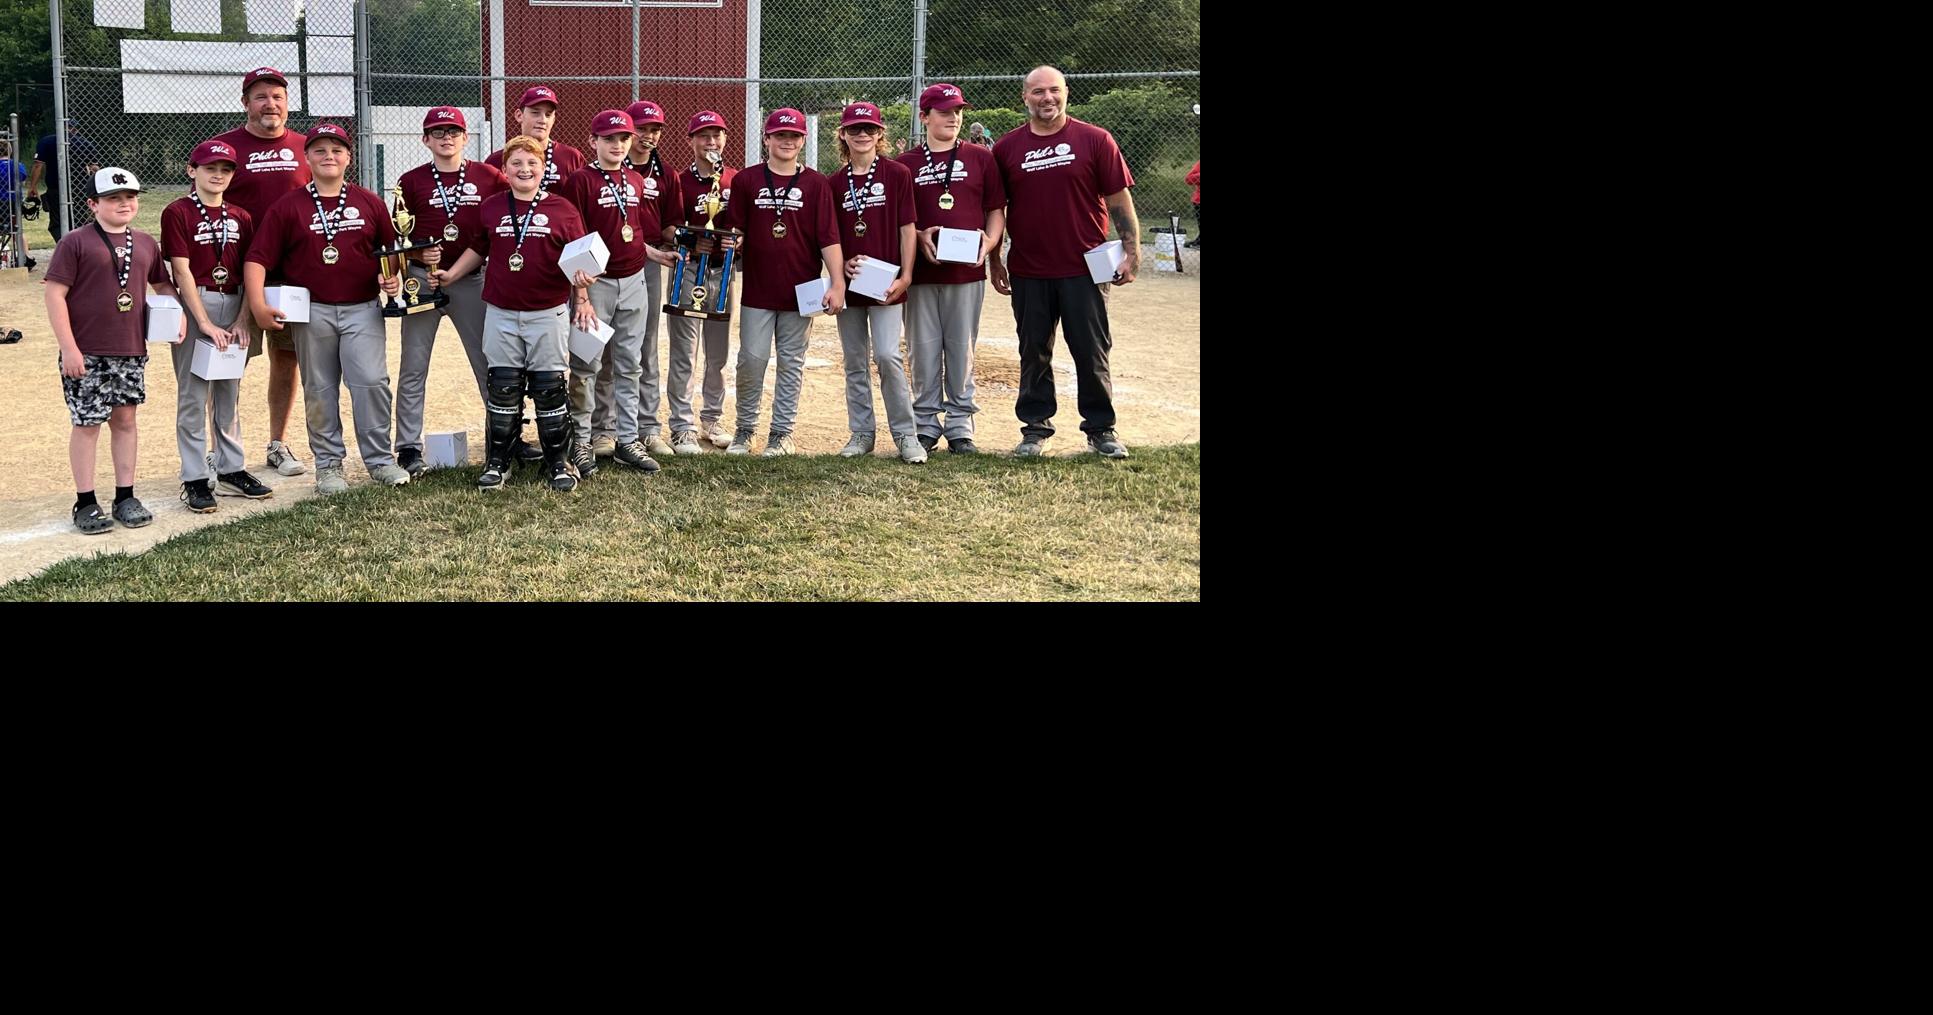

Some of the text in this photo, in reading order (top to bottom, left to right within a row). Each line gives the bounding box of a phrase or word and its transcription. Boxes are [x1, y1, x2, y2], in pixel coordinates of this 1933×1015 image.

[437, 110, 456, 119] WL
[644, 107, 660, 117] WL
[854, 106, 873, 116] WL
[609, 116, 627, 126] WL
[699, 114, 716, 123] WL
[779, 115, 797, 124] WL
